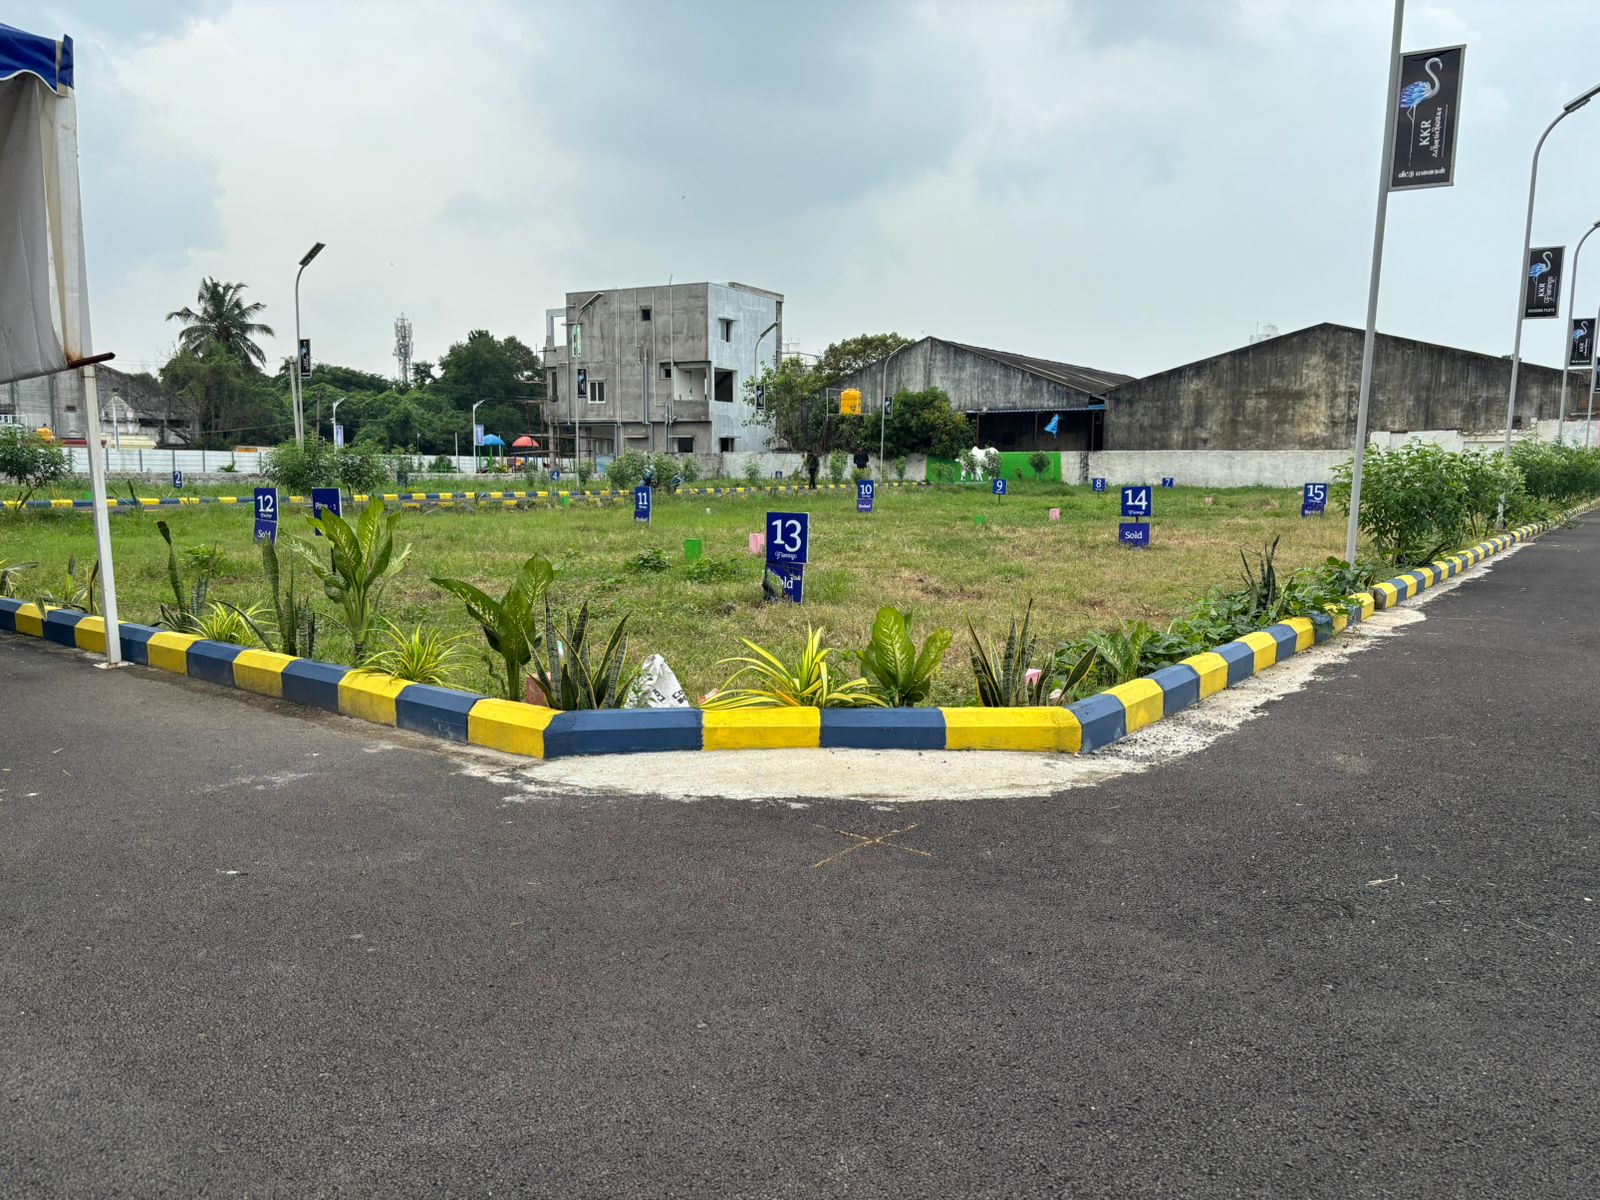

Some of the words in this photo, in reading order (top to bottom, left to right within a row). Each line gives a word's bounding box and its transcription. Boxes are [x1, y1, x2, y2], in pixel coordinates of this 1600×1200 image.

[1419, 119, 1431, 146] KKR
[1538, 282, 1546, 297] KKR
[175, 471, 181, 484] 2
[996, 479, 1002, 488] 8
[860, 484, 872, 495] 10
[996, 480, 1003, 491] 9
[637, 492, 648, 505] 11
[1307, 484, 1324, 501] 15
[257, 495, 274, 512] 12
[1124, 489, 1148, 510] 14
[771, 519, 802, 553] 13
[1125, 530, 1143, 539] Sold
[775, 551, 798, 560] Flamingo
